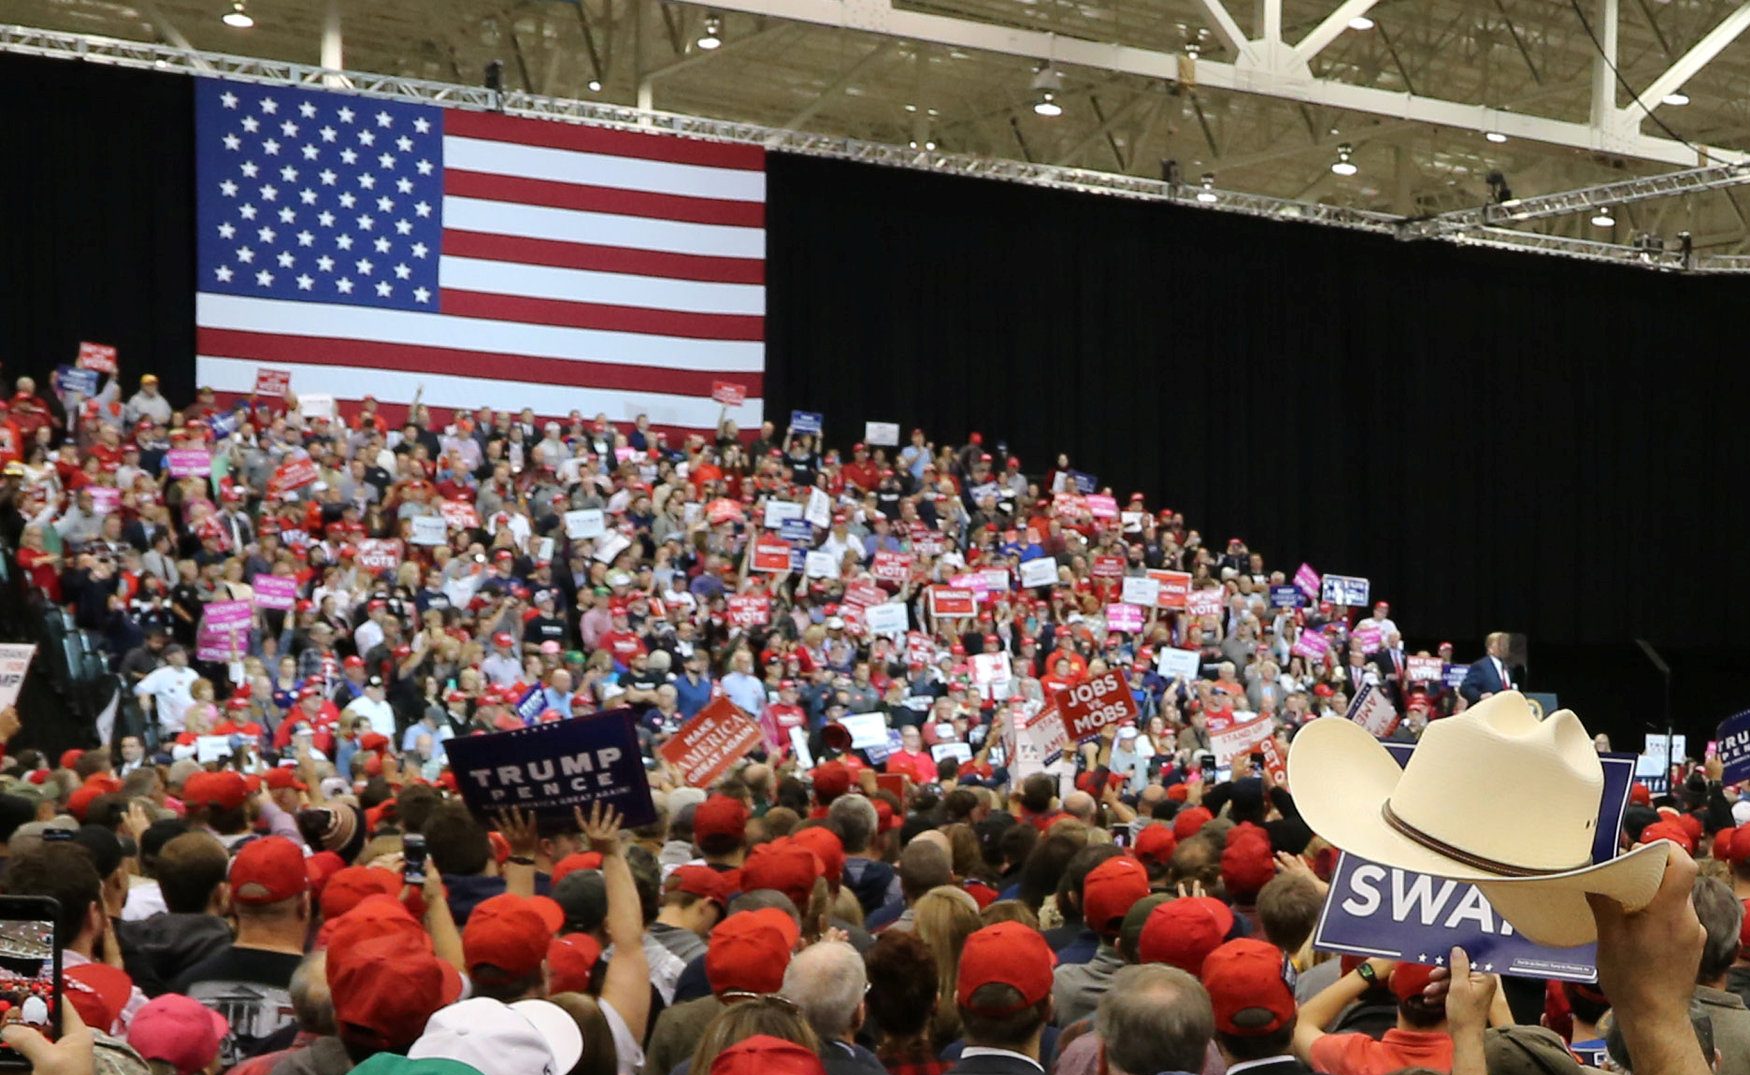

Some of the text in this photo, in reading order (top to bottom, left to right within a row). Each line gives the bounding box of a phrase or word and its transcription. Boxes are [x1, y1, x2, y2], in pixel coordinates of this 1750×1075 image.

[1067, 674, 1119, 708] JOBS
[683, 716, 716, 746] MAKE
[1073, 701, 1129, 735] MOBS
[675, 713, 746, 770] AMERICA
[1259, 739, 1281, 768] GET
[470, 747, 622, 788] TRUMP
[687, 751, 723, 785] GREAT
[490, 772, 614, 801] PENCE
